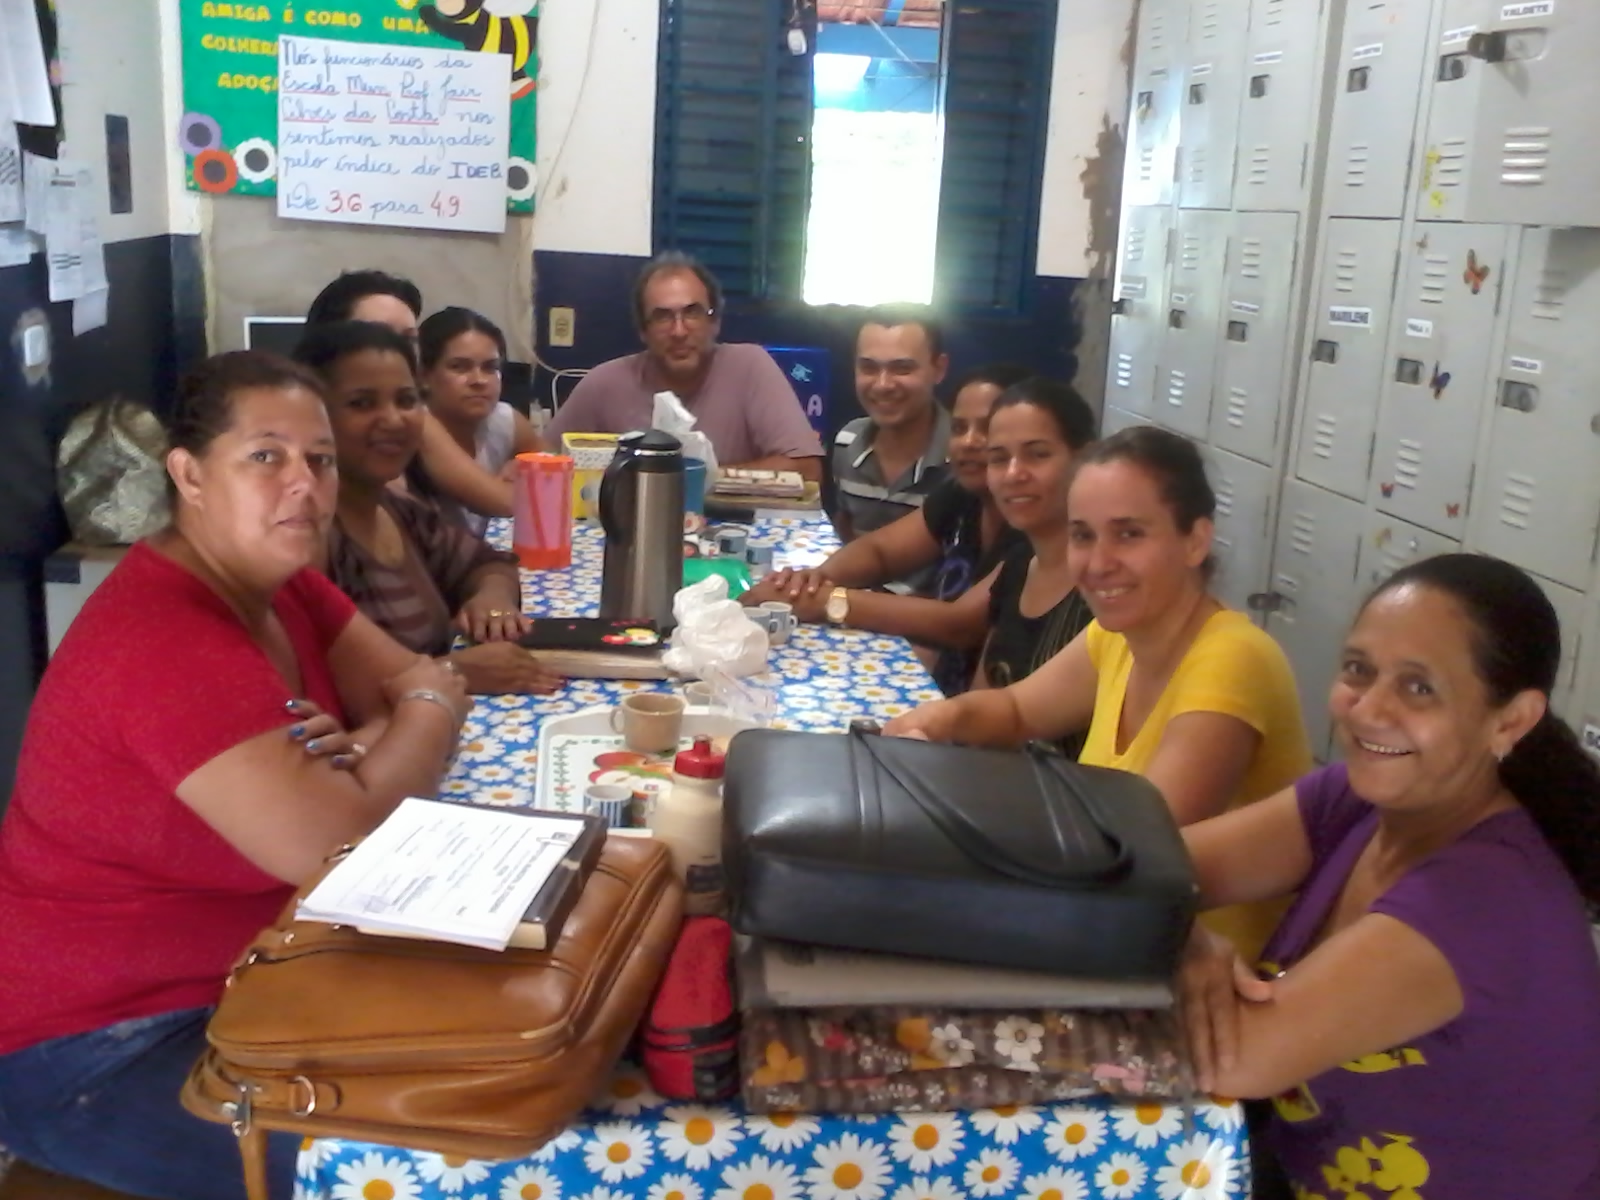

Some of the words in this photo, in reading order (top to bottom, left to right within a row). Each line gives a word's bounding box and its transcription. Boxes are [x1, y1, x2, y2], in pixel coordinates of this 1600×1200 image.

[202, 1, 272, 22] AMIGA
[283, 1, 294, 23] É
[305, 9, 362, 28] COMO
[323, 46, 424, 83] funcionários
[282, 70, 340, 93] Escola
[344, 99, 377, 121] da
[282, 125, 380, 147] sentimos
[389, 127, 495, 161] realizados
[283, 149, 328, 177] pelo
[411, 155, 441, 176] do
[447, 161, 503, 179] IDEB
[368, 200, 425, 220] para
